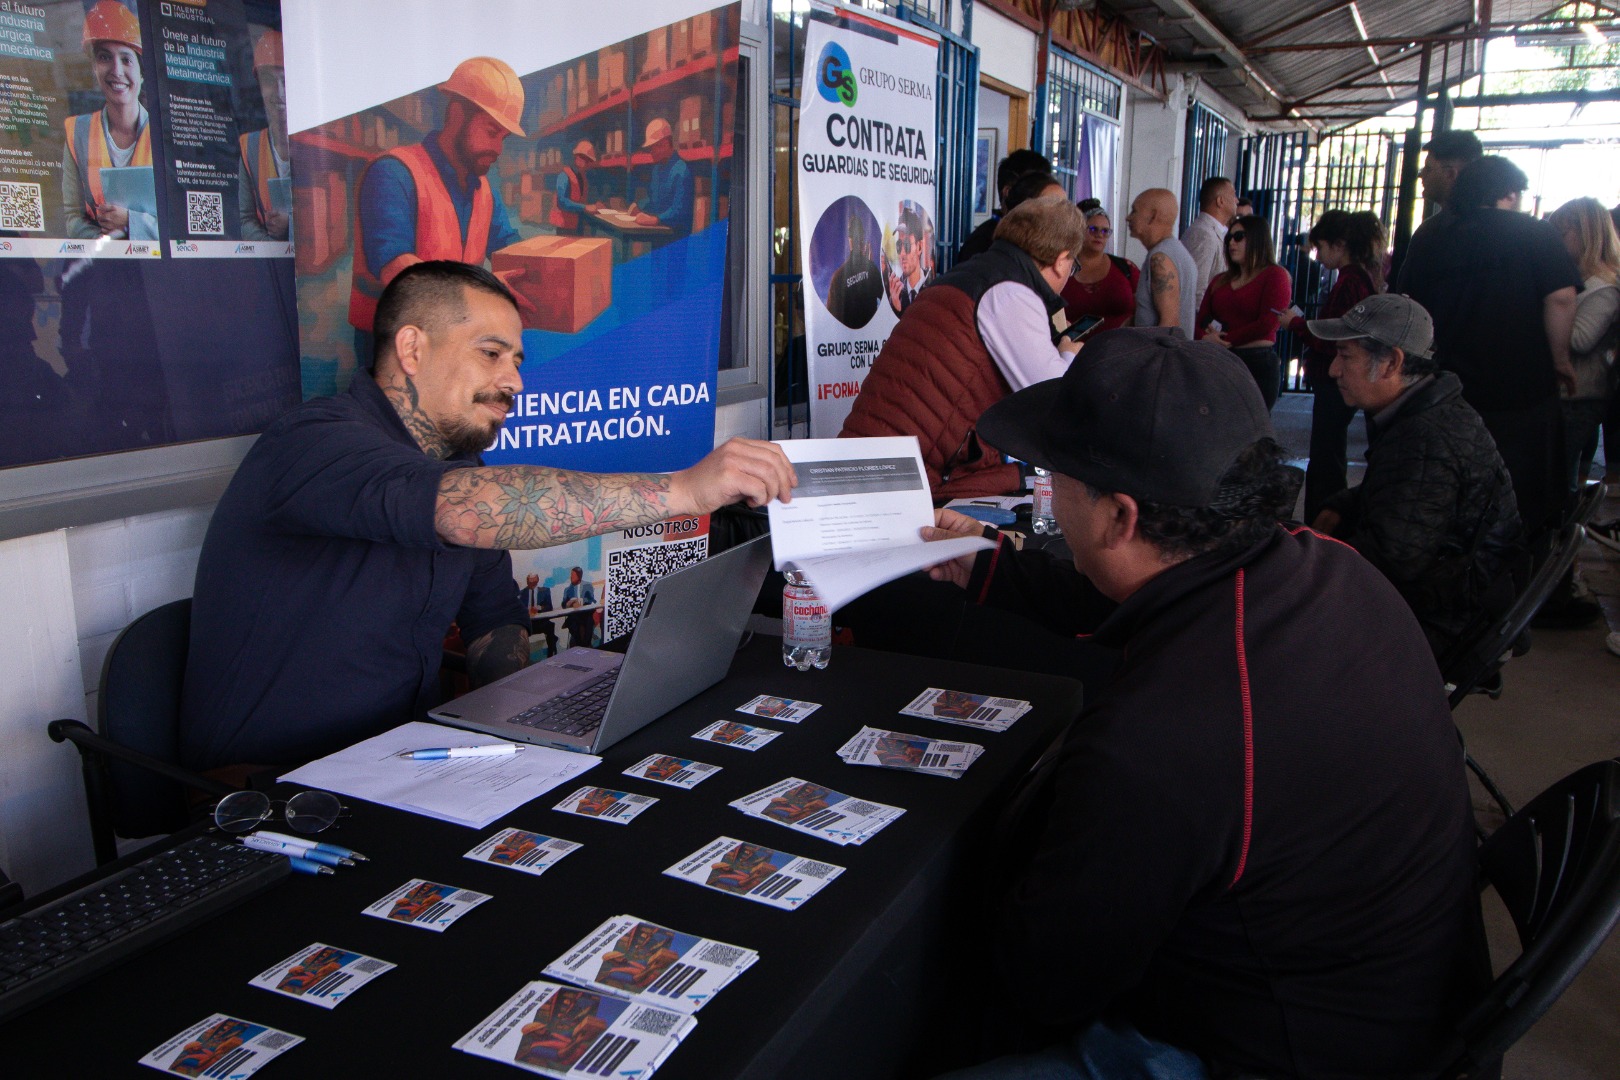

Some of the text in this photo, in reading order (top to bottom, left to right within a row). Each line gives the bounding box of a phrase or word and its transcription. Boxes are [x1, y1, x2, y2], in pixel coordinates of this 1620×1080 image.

[1, 1, 46, 18] al futuro
[172, 4, 204, 16] TALENTO
[173, 12, 216, 25] INDUSTRIAL
[0, 15, 45, 31] ndustria
[0, 27, 33, 43] úrgica
[162, 26, 227, 48] Únete al futuro
[0, 43, 53, 60] mecánica
[164, 41, 225, 60] de la Industria
[165, 53, 216, 71] Metalúrgica
[167, 65, 231, 84] Metalmecánica
[859, 67, 933, 101] GRUPO SERMA
[826, 112, 927, 161] CONTRATA
[802, 153, 936, 187] GUARDIAS DE SEGURIDA
[817, 342, 853, 358] GRUPO
[854, 340, 880, 354] SERMA
[850, 355, 866, 369] CON
[610, 386, 640, 410] EN
[647, 382, 710, 408] CADA
[623, 518, 699, 541] NOSOTROS
